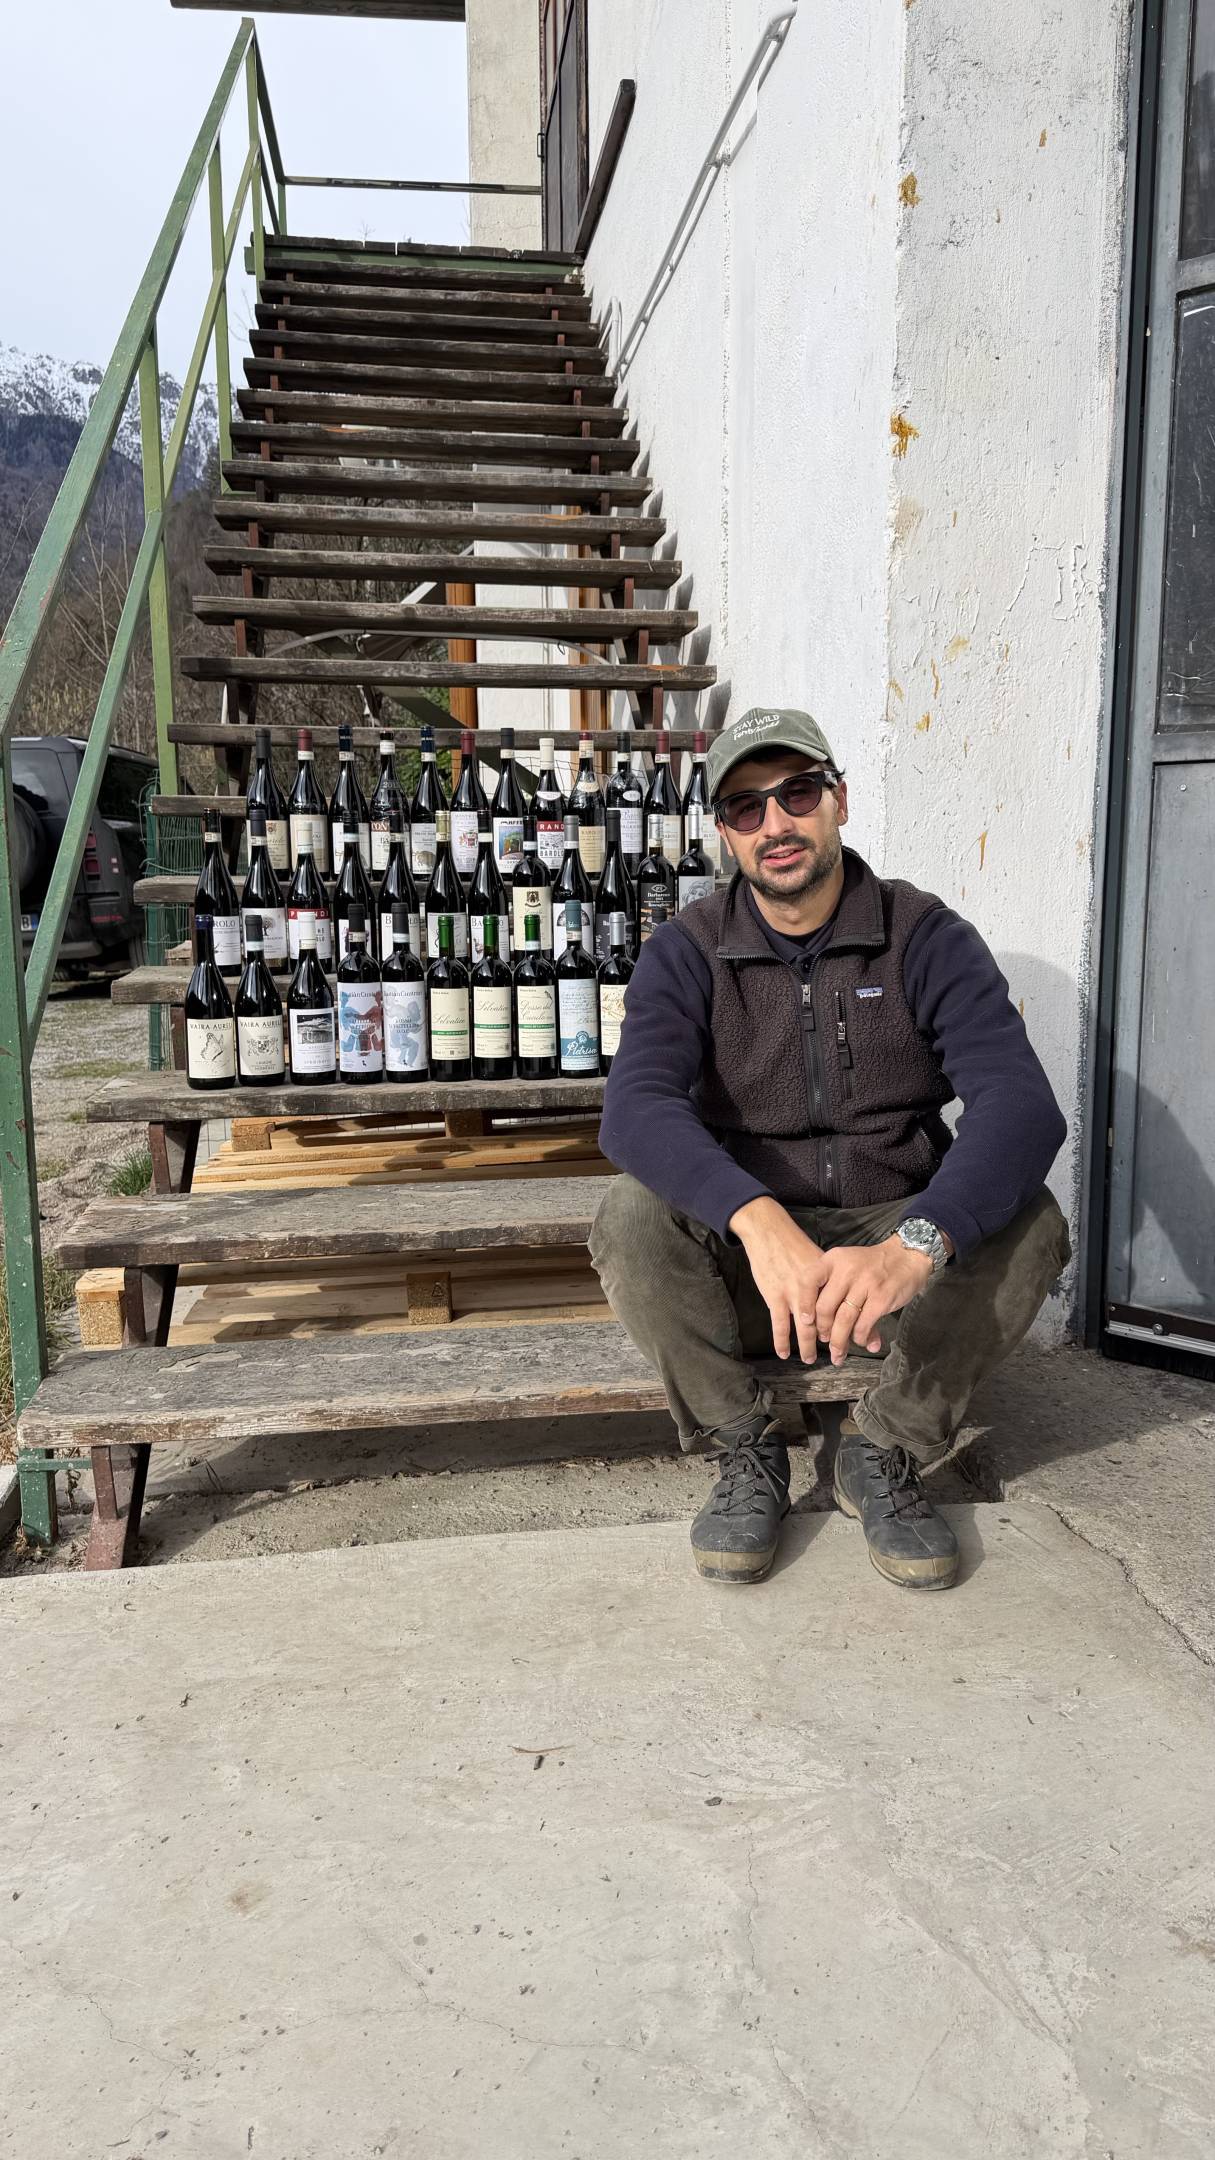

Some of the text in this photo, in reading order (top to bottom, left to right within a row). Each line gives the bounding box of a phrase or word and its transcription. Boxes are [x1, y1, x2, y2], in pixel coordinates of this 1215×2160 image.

[733, 719, 754, 735] STAY
[754, 714, 780, 726] WILD
[213, 919, 236, 928] ROLO
